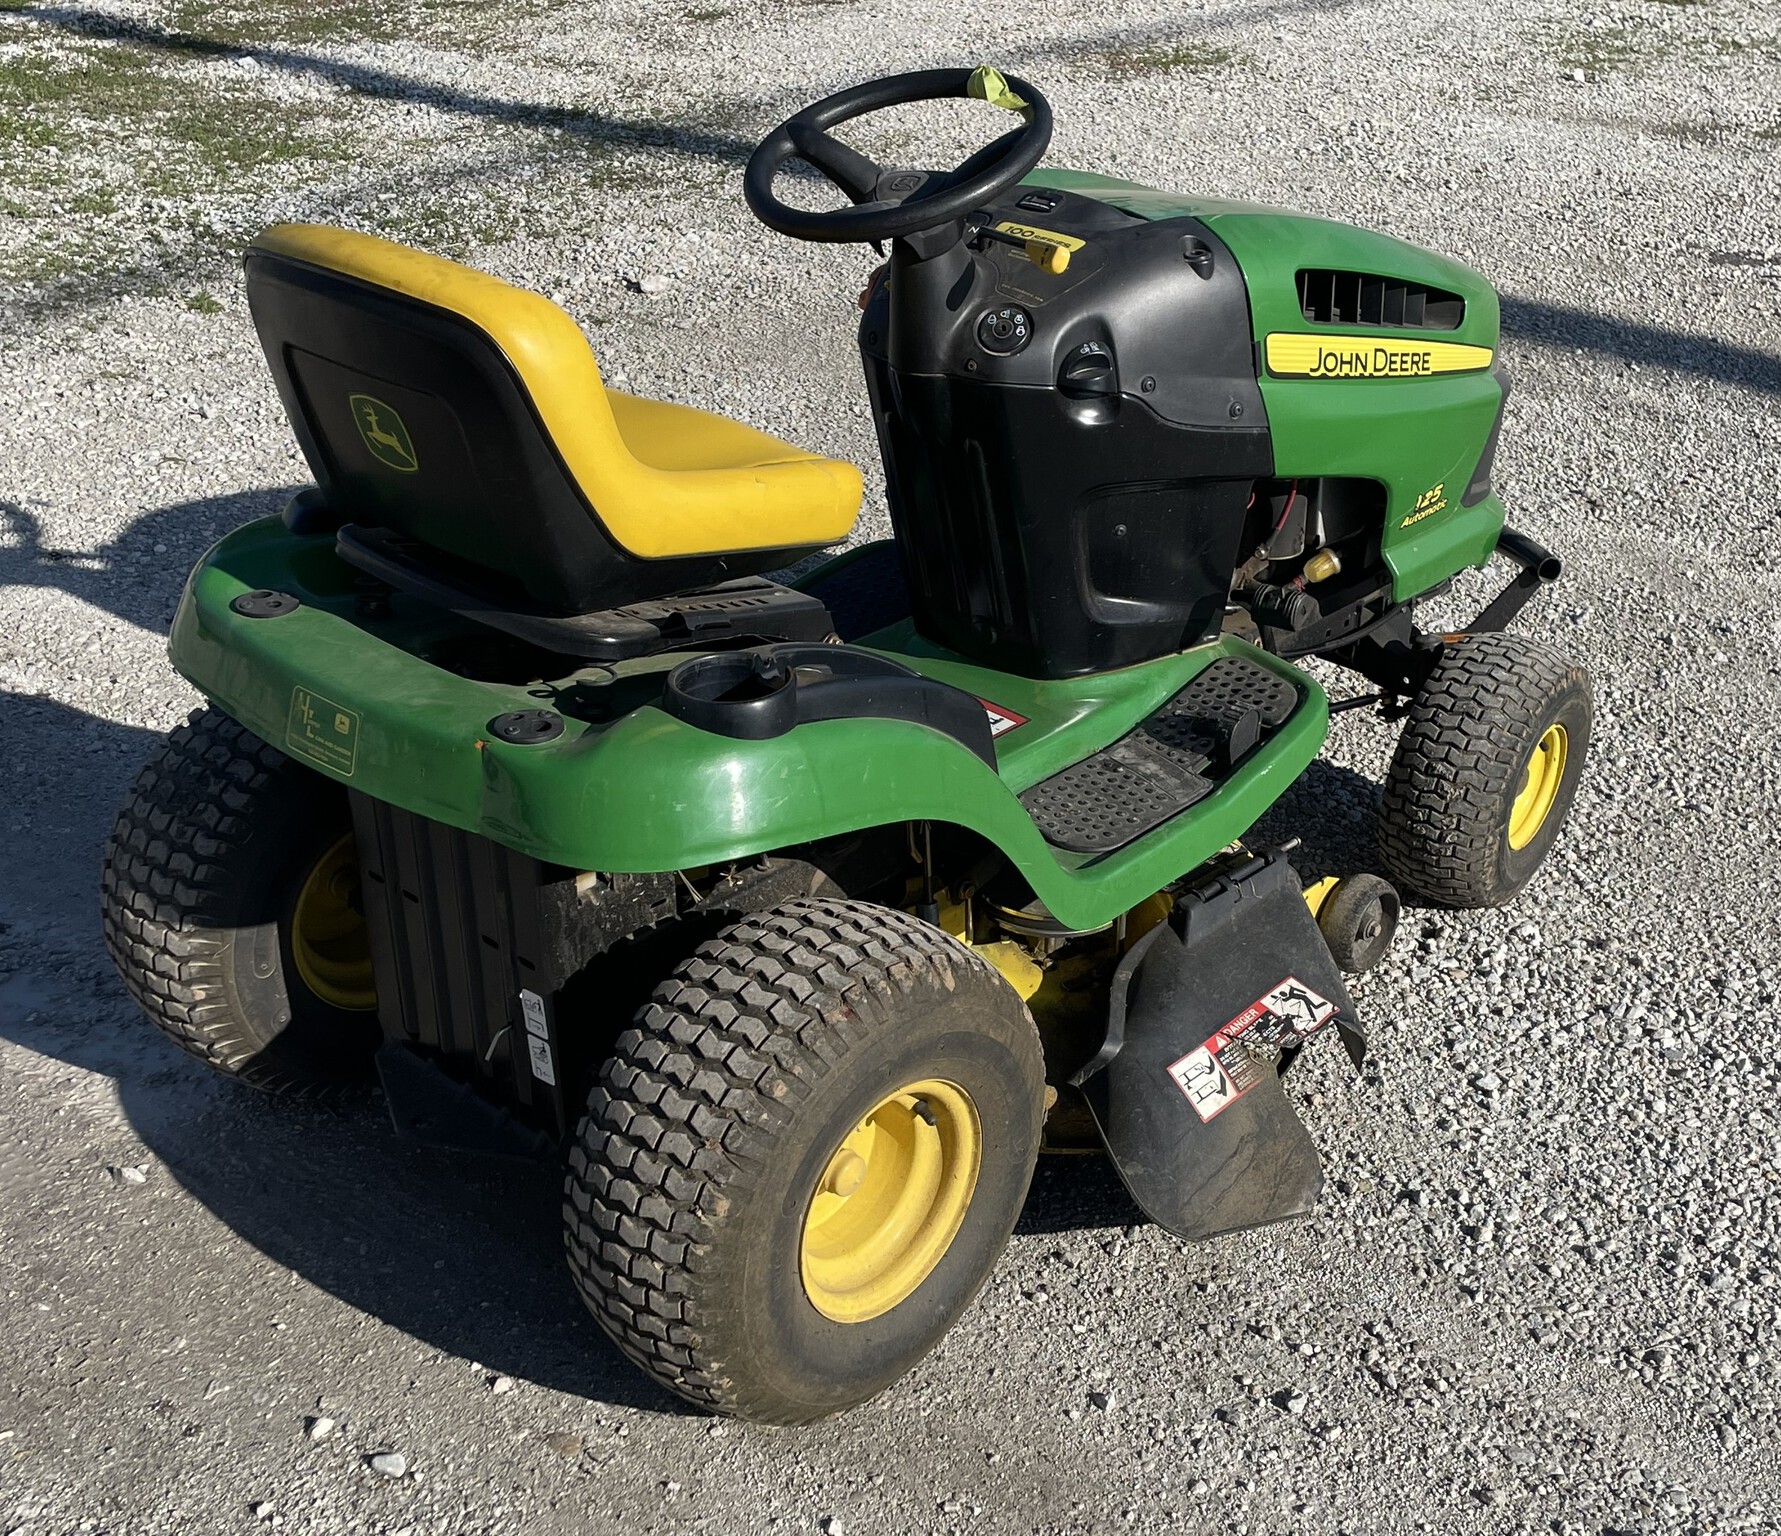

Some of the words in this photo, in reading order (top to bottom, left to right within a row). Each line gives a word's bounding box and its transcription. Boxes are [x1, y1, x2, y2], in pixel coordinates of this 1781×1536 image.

[968, 226, 980, 234] N
[1004, 226, 1035, 238] 100
[1309, 347, 1368, 373] JOHN
[1373, 347, 1431, 373] DEERE
[1415, 483, 1444, 511] 125
[1400, 498, 1448, 529] Automatic
[1221, 1008, 1259, 1042] DANGER
